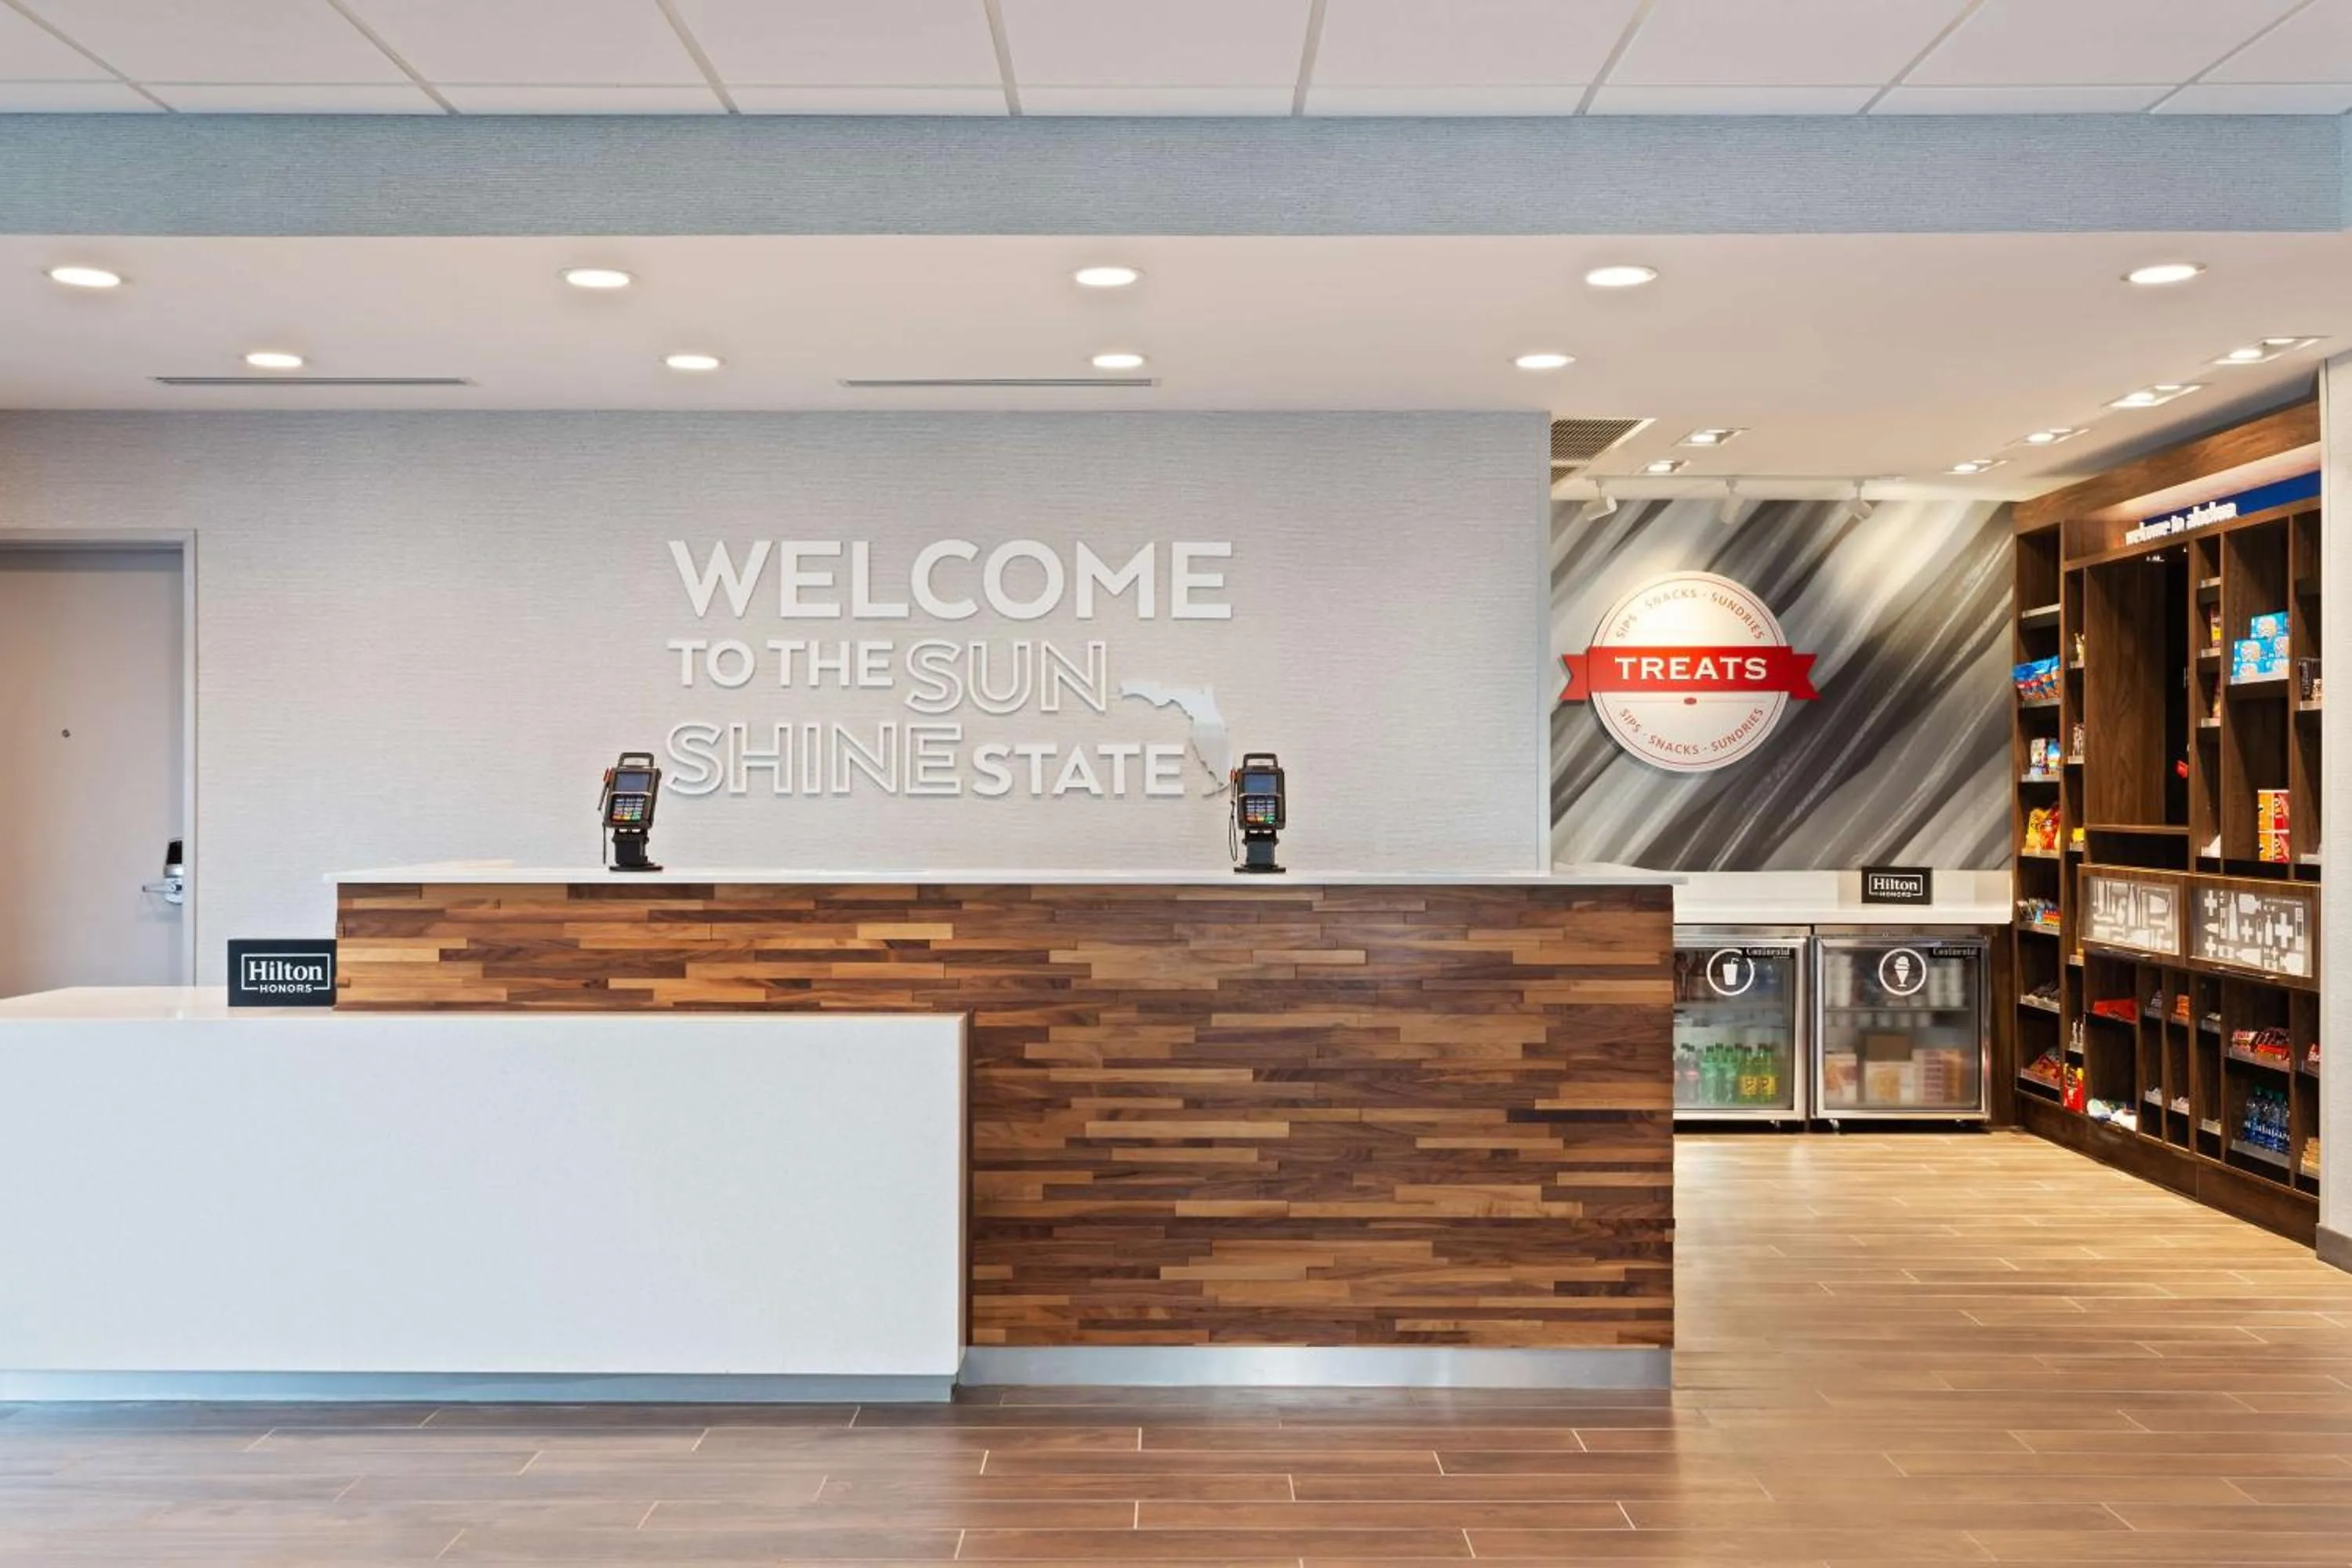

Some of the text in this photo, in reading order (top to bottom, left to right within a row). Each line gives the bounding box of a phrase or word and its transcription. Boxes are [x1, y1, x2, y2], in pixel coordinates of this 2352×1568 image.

[668, 539, 1233, 620] WELCOME
[1616, 588, 1766, 640] SIPS SNACKS SUNDRIES
[668, 639, 1107, 714] TO THE SUN
[1614, 656, 1768, 681] TREATS
[1619, 707, 1764, 755] SIPS SNACKS SUNDRIES
[665, 721, 1186, 797] SHINE STATE
[1873, 877, 1918, 891] Hilton
[249, 960, 324, 981] Hilton
[260, 984, 313, 993] HONORS
